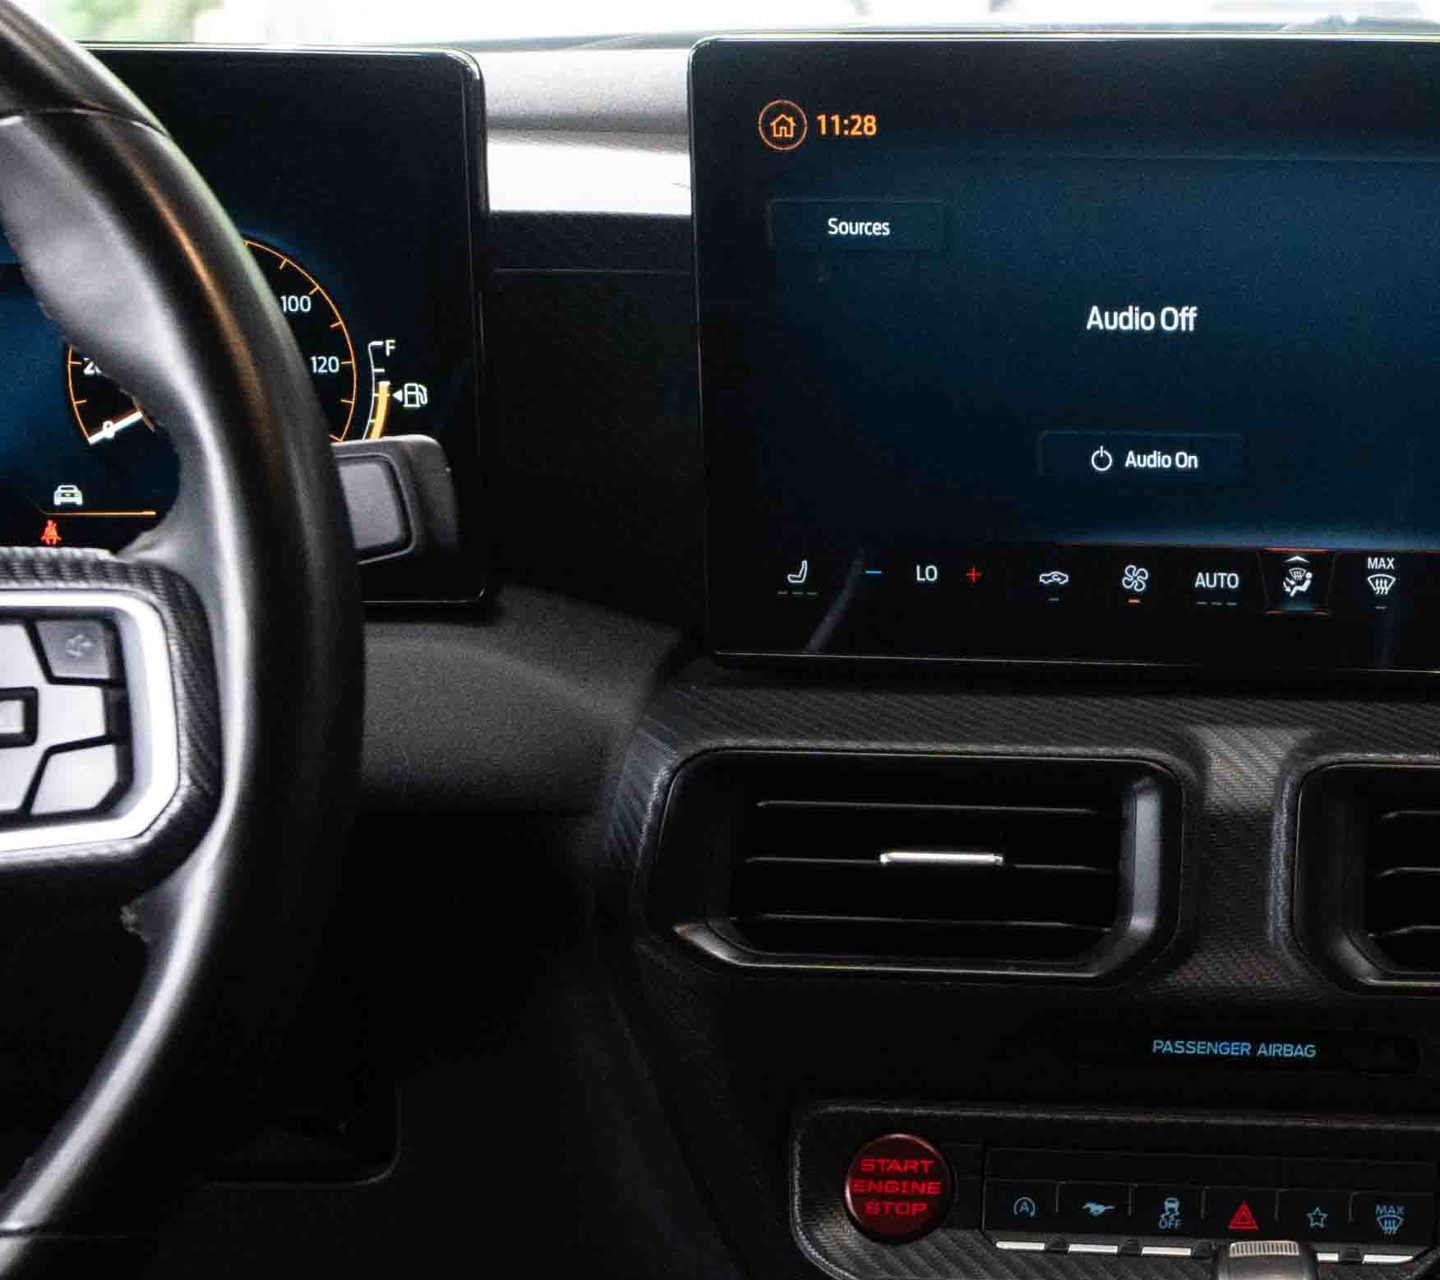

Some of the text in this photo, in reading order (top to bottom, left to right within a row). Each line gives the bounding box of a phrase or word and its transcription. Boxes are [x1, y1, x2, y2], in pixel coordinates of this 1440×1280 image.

[816, 114, 877, 136] 11:28
[827, 217, 891, 236] Sources
[280, 295, 312, 313] 100
[1086, 305, 1199, 332] Audio Off
[385, 339, 396, 357] F
[310, 355, 340, 374] 120
[1124, 449, 1199, 469] Audio On
[1367, 556, 1395, 570] MAX
[916, 564, 938, 582] LO
[1194, 572, 1240, 589] AUTO
[1152, 1039, 1317, 1058] PASSENGER AIRBAG
[861, 1158, 933, 1172] START
[852, 1179, 941, 1195] ENGINE
[865, 1201, 928, 1216] STOP
[1375, 1204, 1406, 1216] MAX
[1158, 1217, 1182, 1230] OFF
